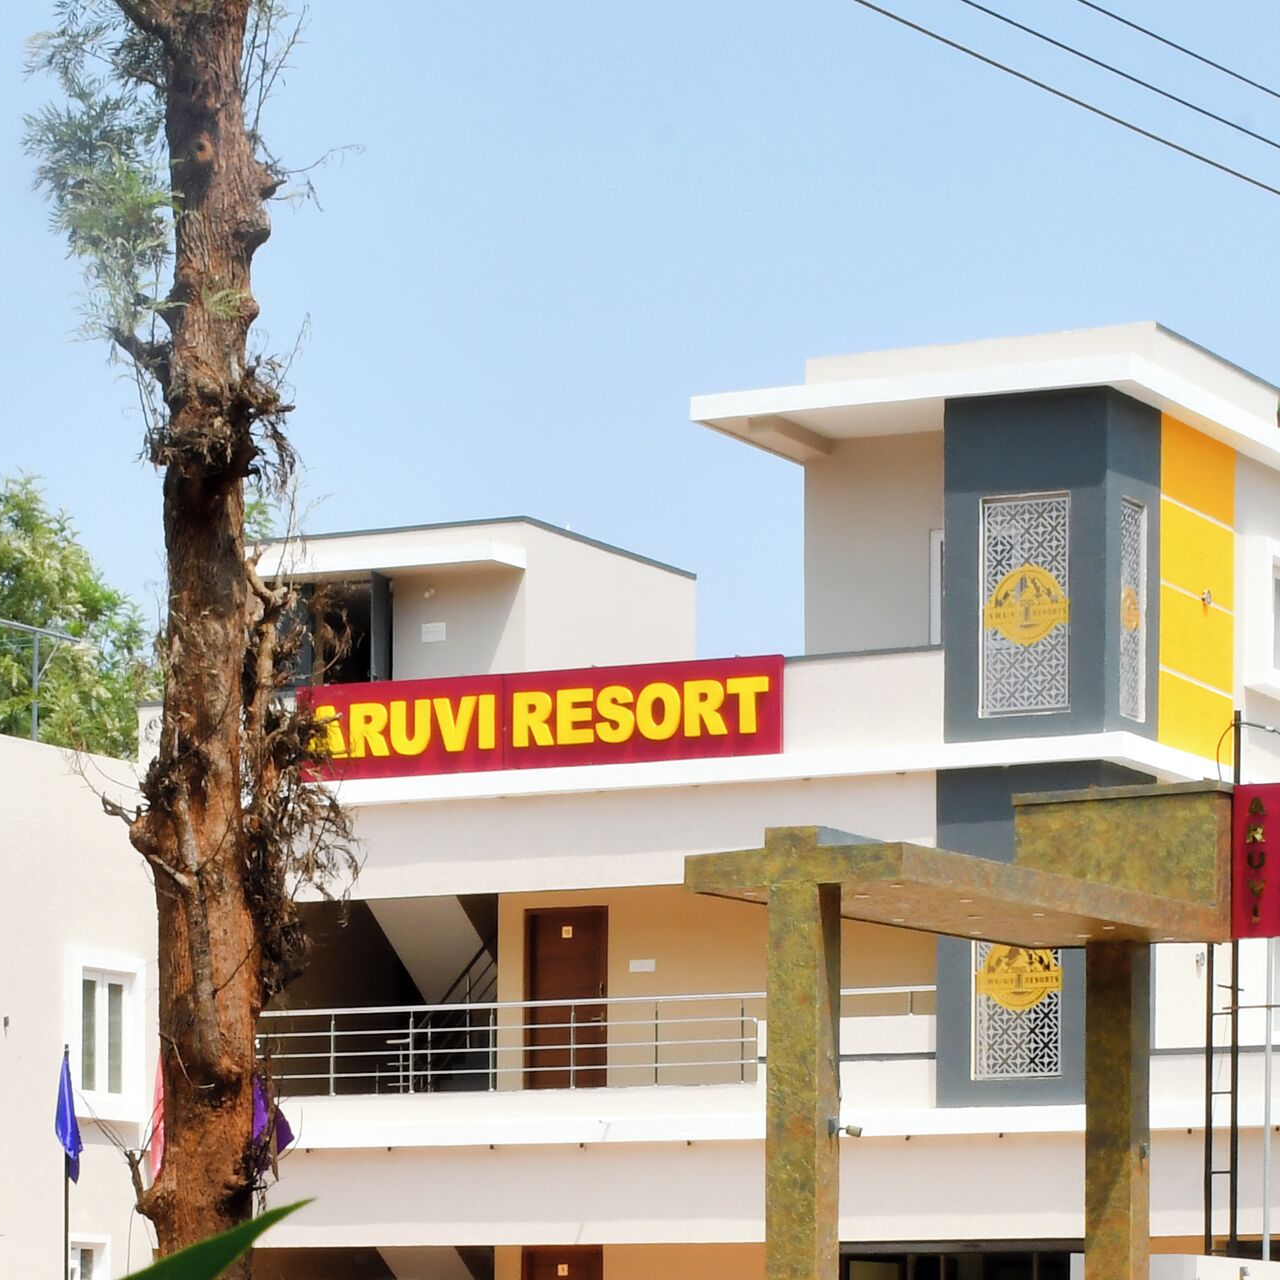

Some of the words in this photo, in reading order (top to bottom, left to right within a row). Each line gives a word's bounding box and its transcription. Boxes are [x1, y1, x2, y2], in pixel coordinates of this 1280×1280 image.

[307, 694, 496, 759] ARUVI
[512, 676, 769, 748] RESORT
[1246, 797, 1266, 923] ARUVI
